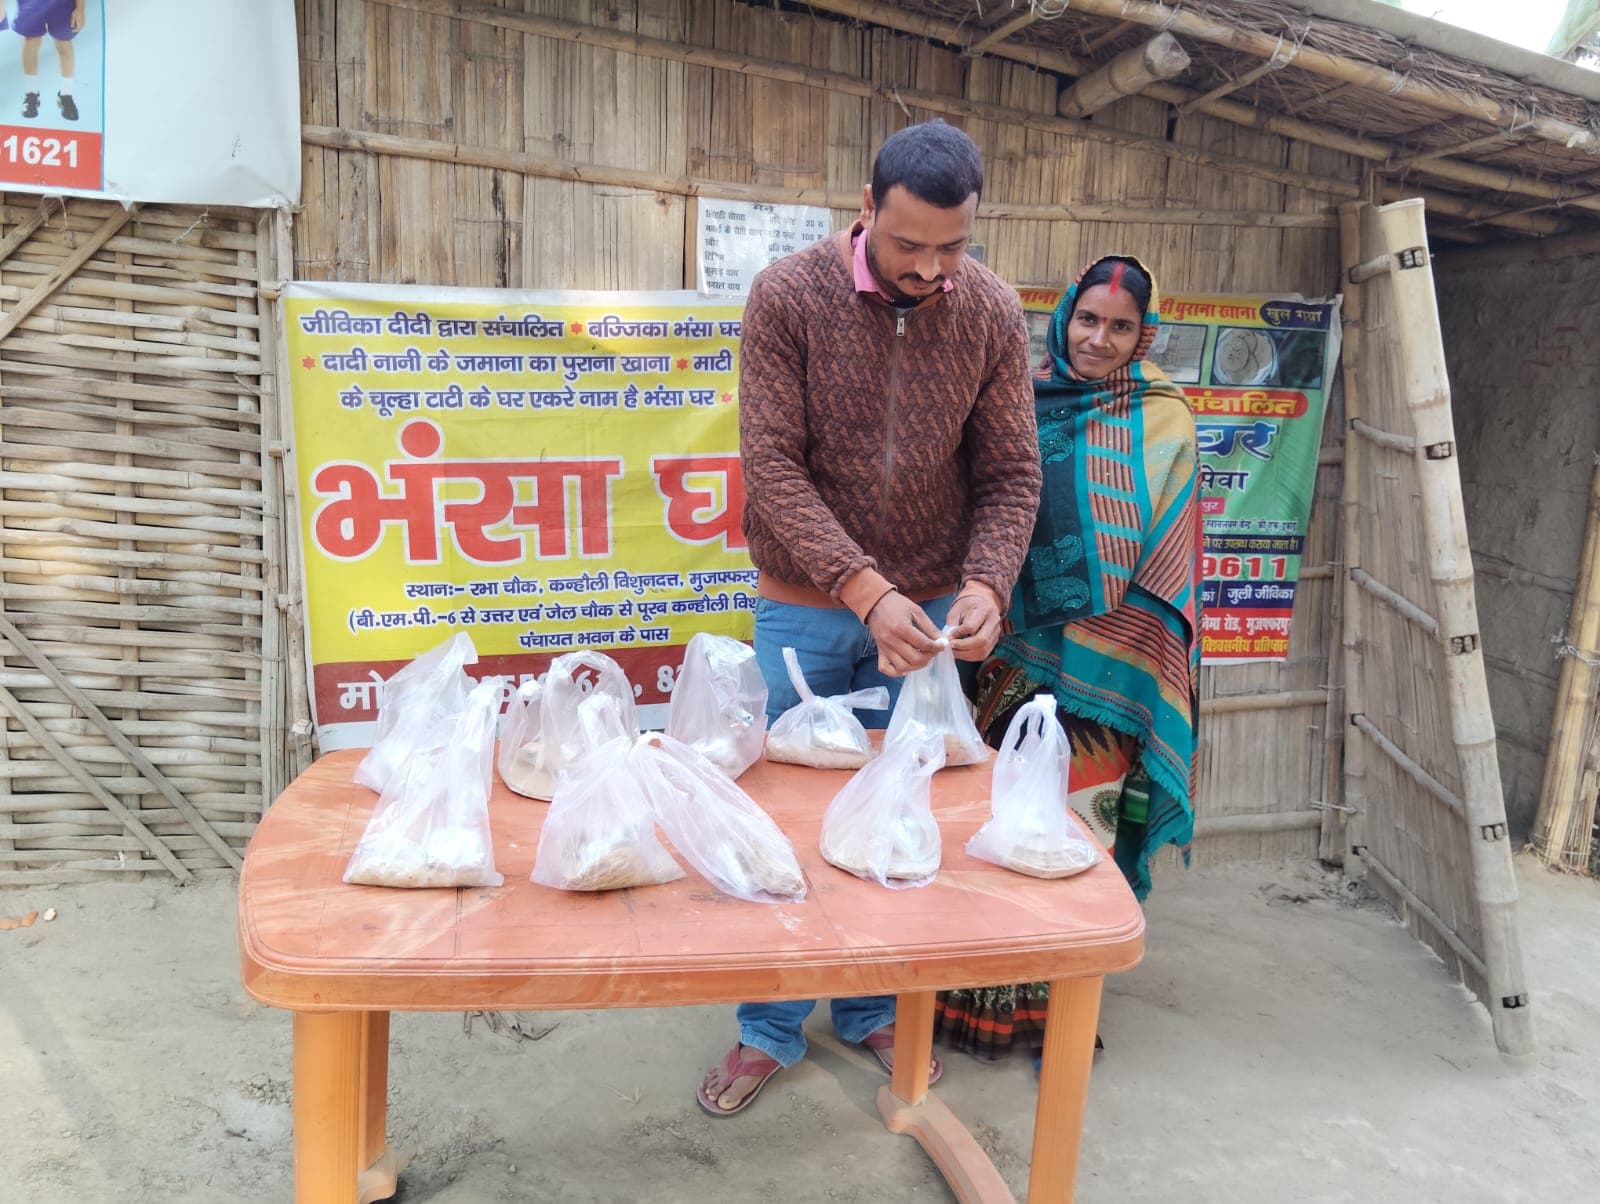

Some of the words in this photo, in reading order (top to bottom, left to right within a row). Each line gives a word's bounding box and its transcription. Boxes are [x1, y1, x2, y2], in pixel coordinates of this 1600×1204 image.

[0, 134, 78, 168] 1621
[301, 309, 381, 335] जीविका
[388, 311, 431, 335] दीदी
[437, 319, 477, 337] द्वारा
[482, 315, 564, 337] संचालित
[588, 315, 668, 337] बज्जिका
[674, 316, 713, 337] भंसा
[323, 349, 367, 372] दादी
[373, 349, 421, 372] नानी
[428, 349, 450, 372] के
[455, 355, 523, 372] जमाना
[529, 356, 556, 372] का
[562, 356, 615, 381] पुराना
[621, 356, 670, 372] खाना
[694, 349, 732, 371] माटी
[341, 386, 363, 408] के
[369, 391, 420, 416] चूल्हा
[425, 386, 463, 408] टाटी
[469, 385, 491, 408] के
[496, 391, 524, 408] घर
[529, 385, 576, 408] एकरे
[580, 391, 617, 407] नाम
[624, 384, 640, 408] है
[645, 385, 684, 406] भंसा
[690, 390, 714, 406] घर
[1189, 390, 1297, 415] संचालित
[313, 420, 621, 562] भंसा
[503, 576, 543, 594] चौक,
[548, 572, 609, 593] कन्हौली
[461, 606, 475, 623] से
[481, 609, 513, 622] उत्तर
[519, 603, 543, 622] एवं
[545, 602, 577, 619] जेल
[582, 600, 614, 617] चौक
[619, 599, 633, 616] से
[638, 602, 667, 621] पूरब
[672, 593, 729, 612] कन्हौली
[520, 631, 573, 647] पंचायत
[578, 632, 614, 645] भवन
[619, 626, 635, 642] के
[640, 628, 669, 641] पास
